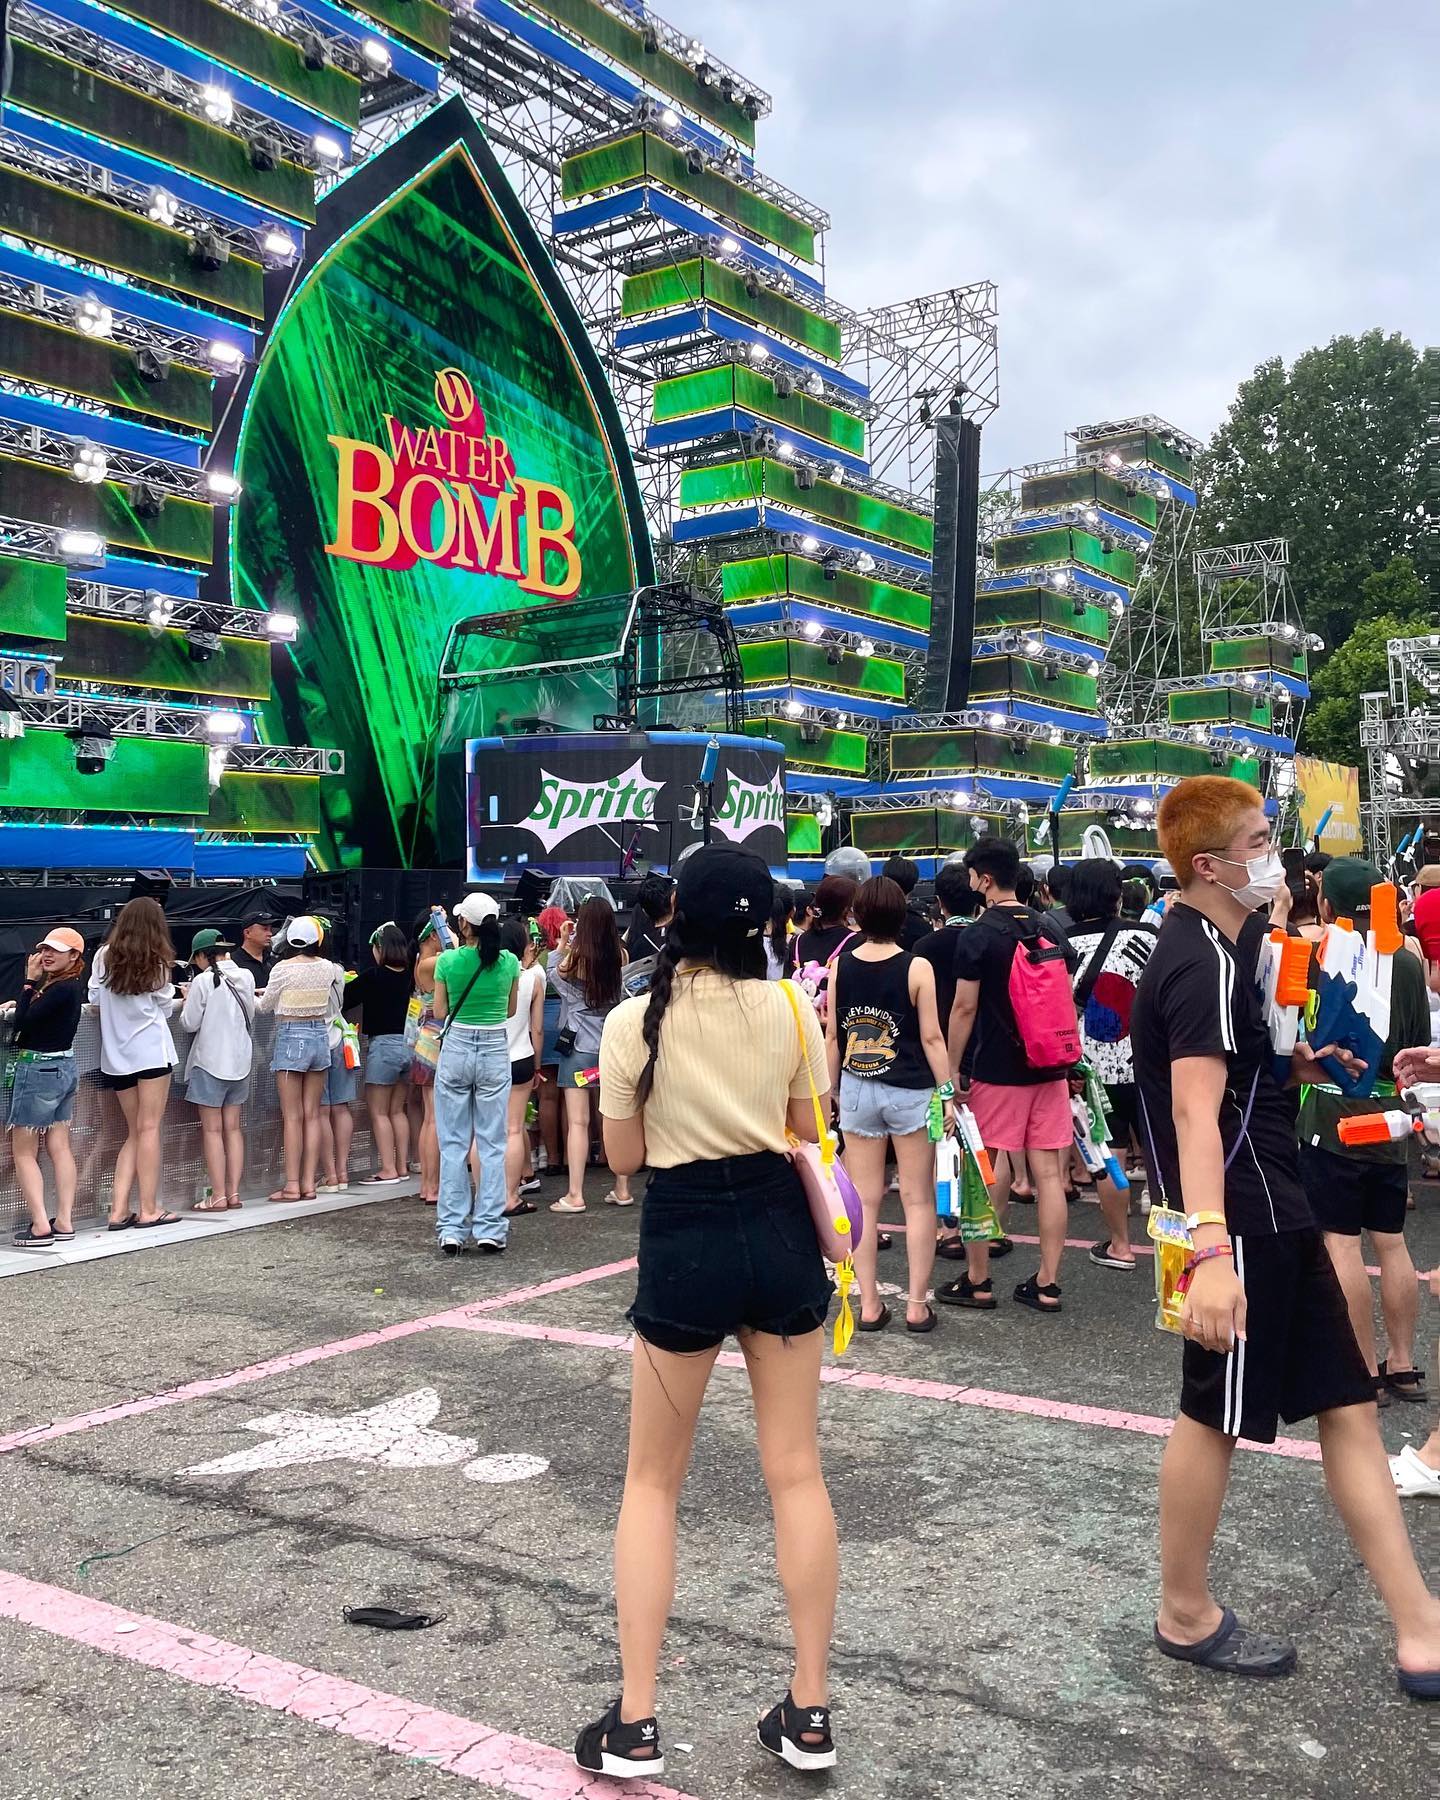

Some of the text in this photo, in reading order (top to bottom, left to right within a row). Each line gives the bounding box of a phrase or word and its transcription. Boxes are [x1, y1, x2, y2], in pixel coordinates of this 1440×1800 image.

[382, 413, 520, 493] WATER
[324, 434, 582, 597] BOMB
[528, 777, 657, 829] Sprite
[851, 1060, 879, 1069] MUSEUM
